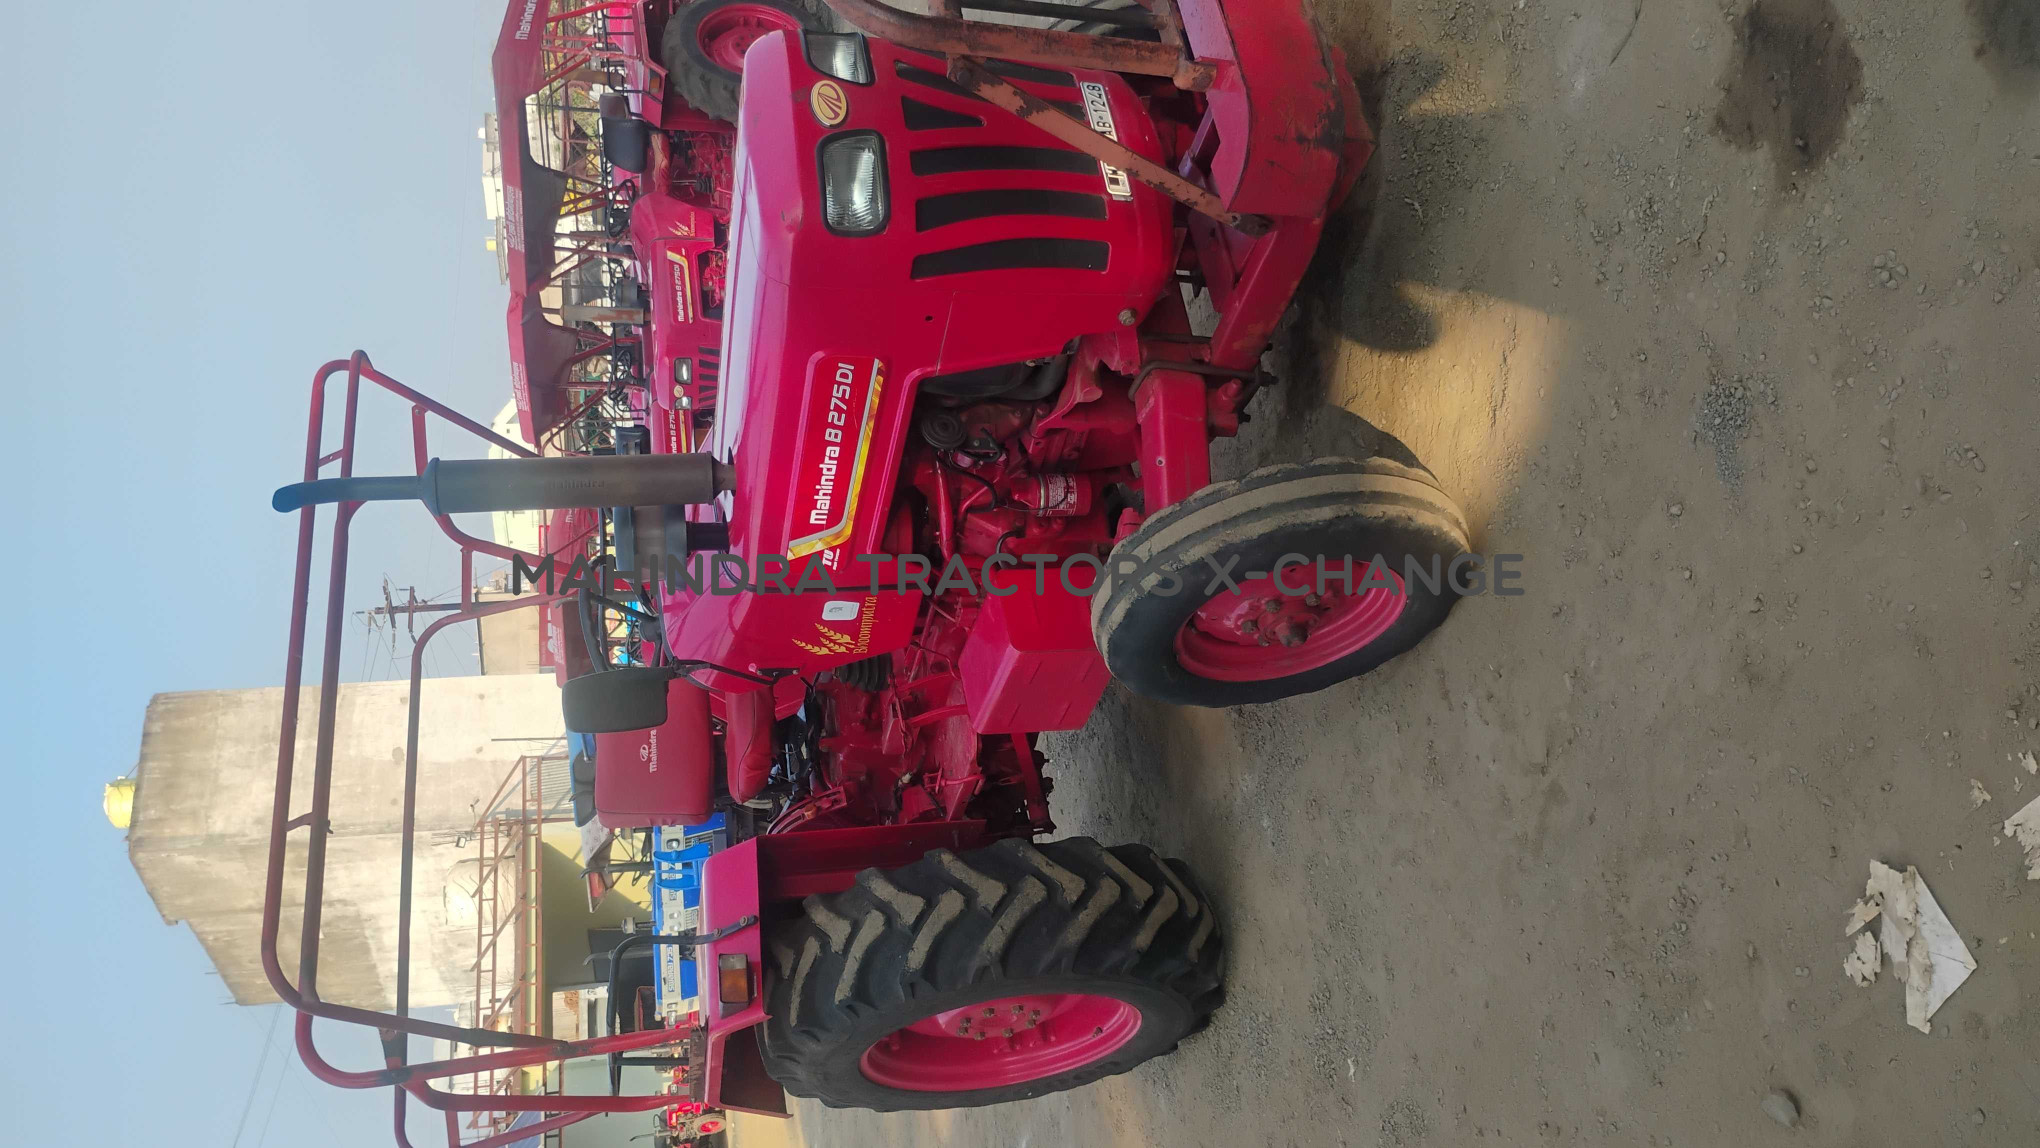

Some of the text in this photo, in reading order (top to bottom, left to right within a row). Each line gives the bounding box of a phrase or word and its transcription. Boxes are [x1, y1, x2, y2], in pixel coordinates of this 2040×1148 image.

[670, 436, 678, 454] ndra
[824, 428, 843, 442] B
[809, 446, 841, 524] Mahindra
[852, 596, 880, 654] Bhoomiputra
[649, 729, 658, 774] Mahindra
